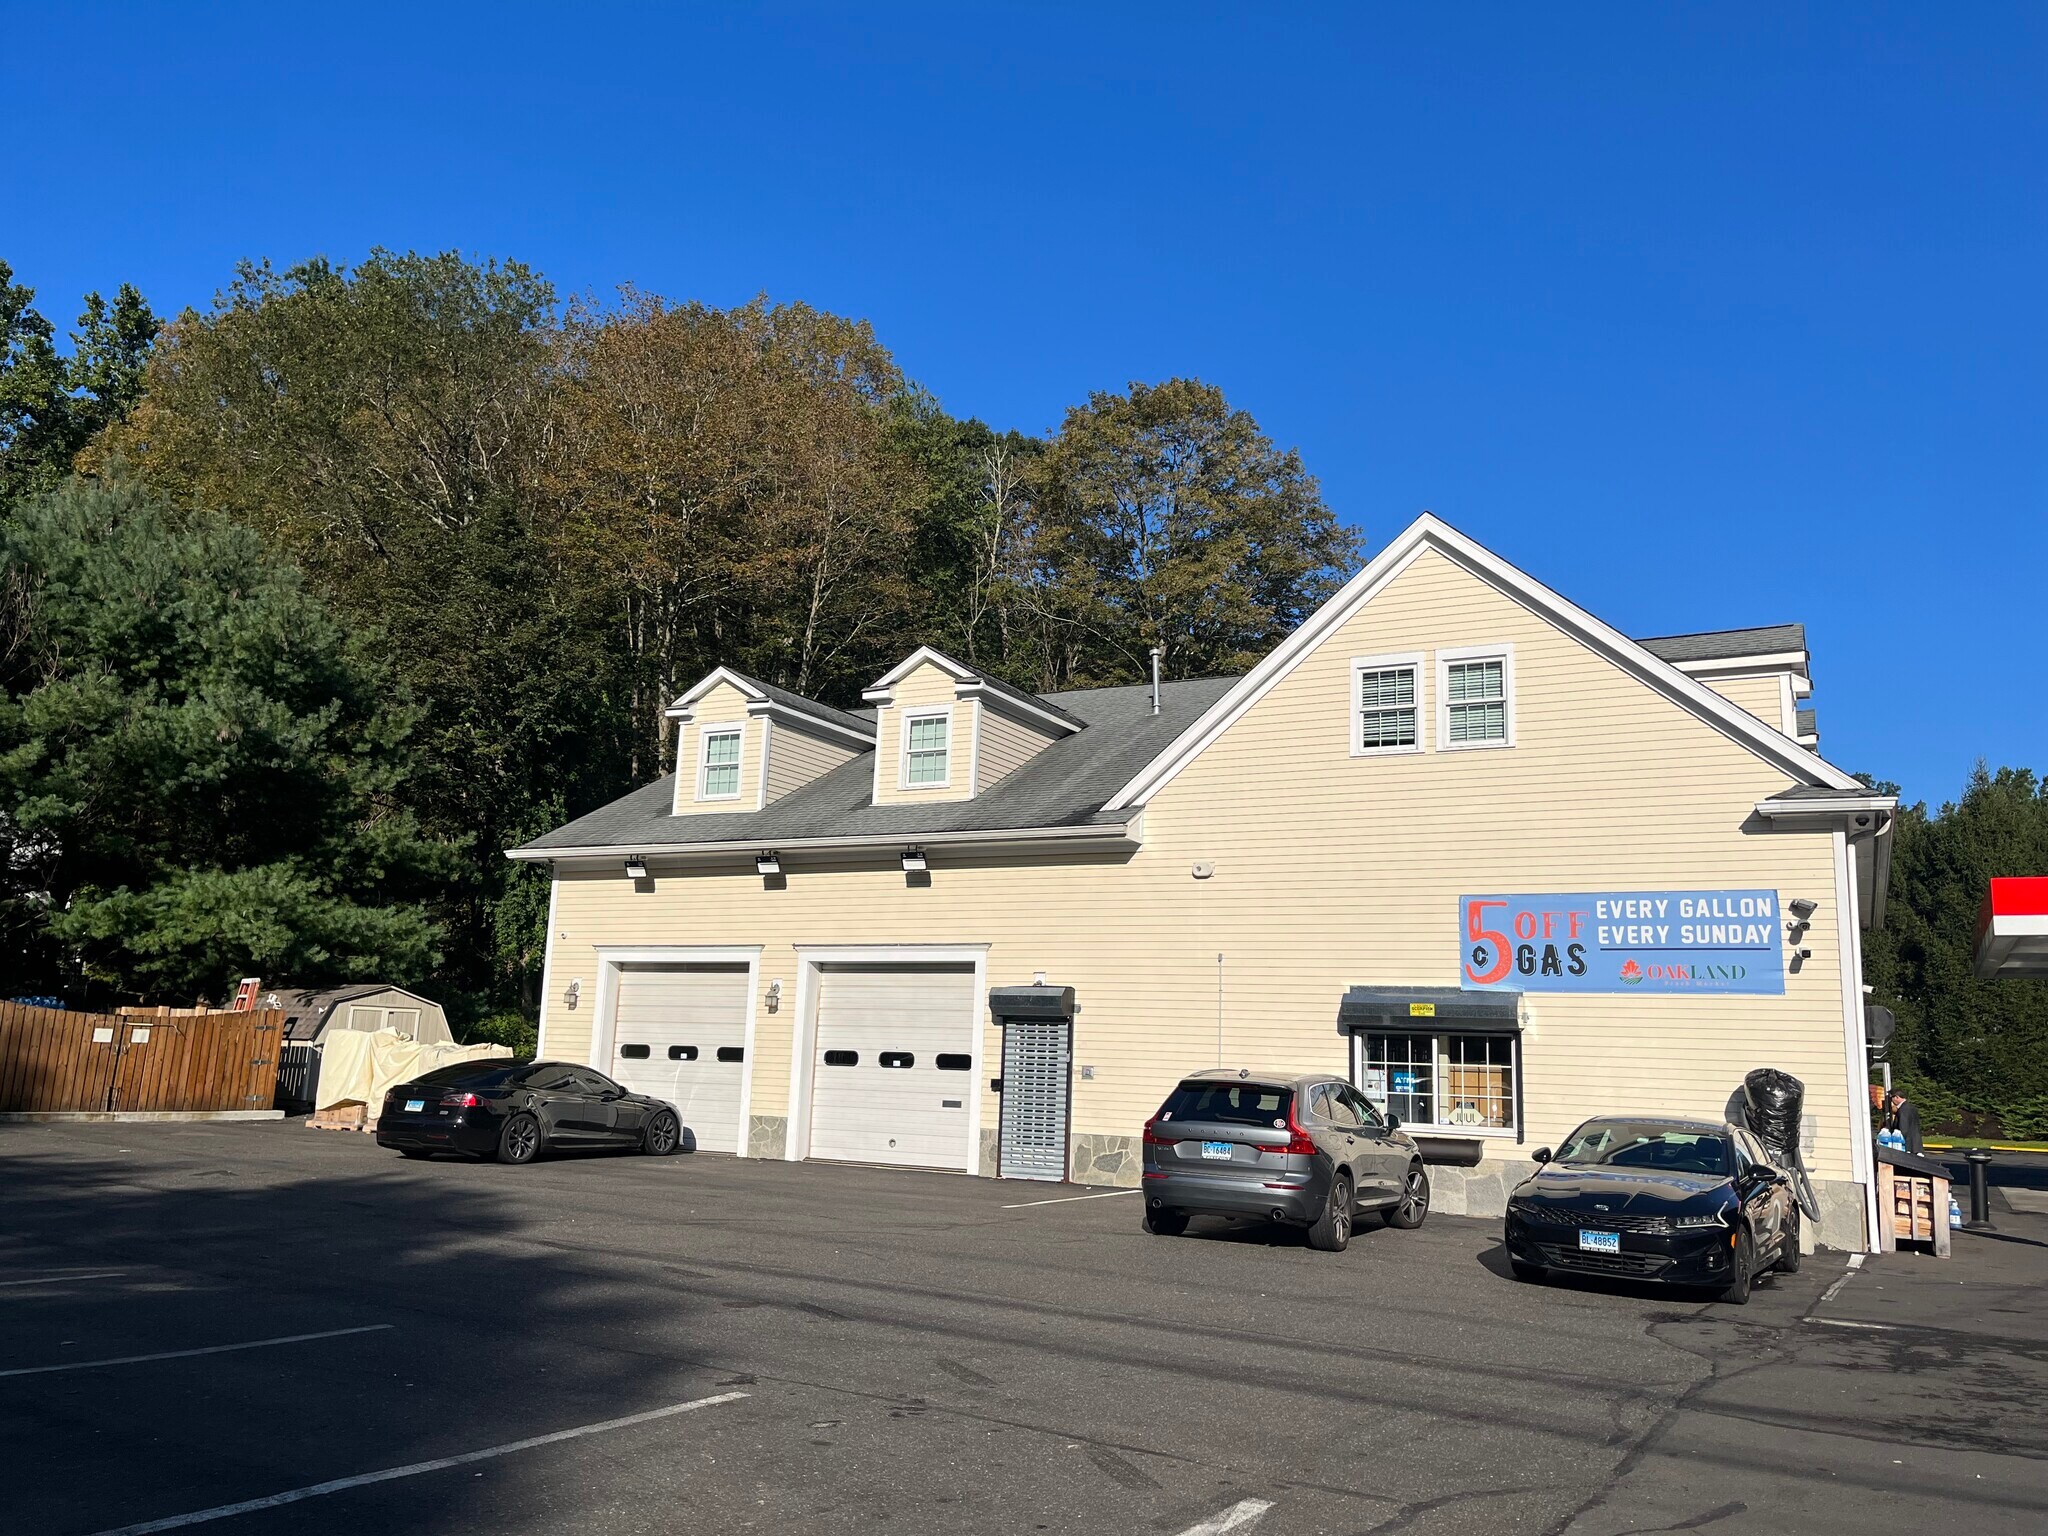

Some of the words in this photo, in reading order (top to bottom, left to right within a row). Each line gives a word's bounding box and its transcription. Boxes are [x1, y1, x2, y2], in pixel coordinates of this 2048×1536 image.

[1596, 899, 1669, 920] EVERY
[1679, 898, 1772, 918] GALLON
[1465, 900, 1513, 984] 5
[1514, 911, 1589, 940] OFF
[1598, 925, 1670, 945] EVERY
[1681, 924, 1773, 944] SUNDAY
[1516, 943, 1588, 977] GAS
[1647, 965, 1746, 980] OAKLAND
[1187, 1128, 1245, 1137] VOLVO
